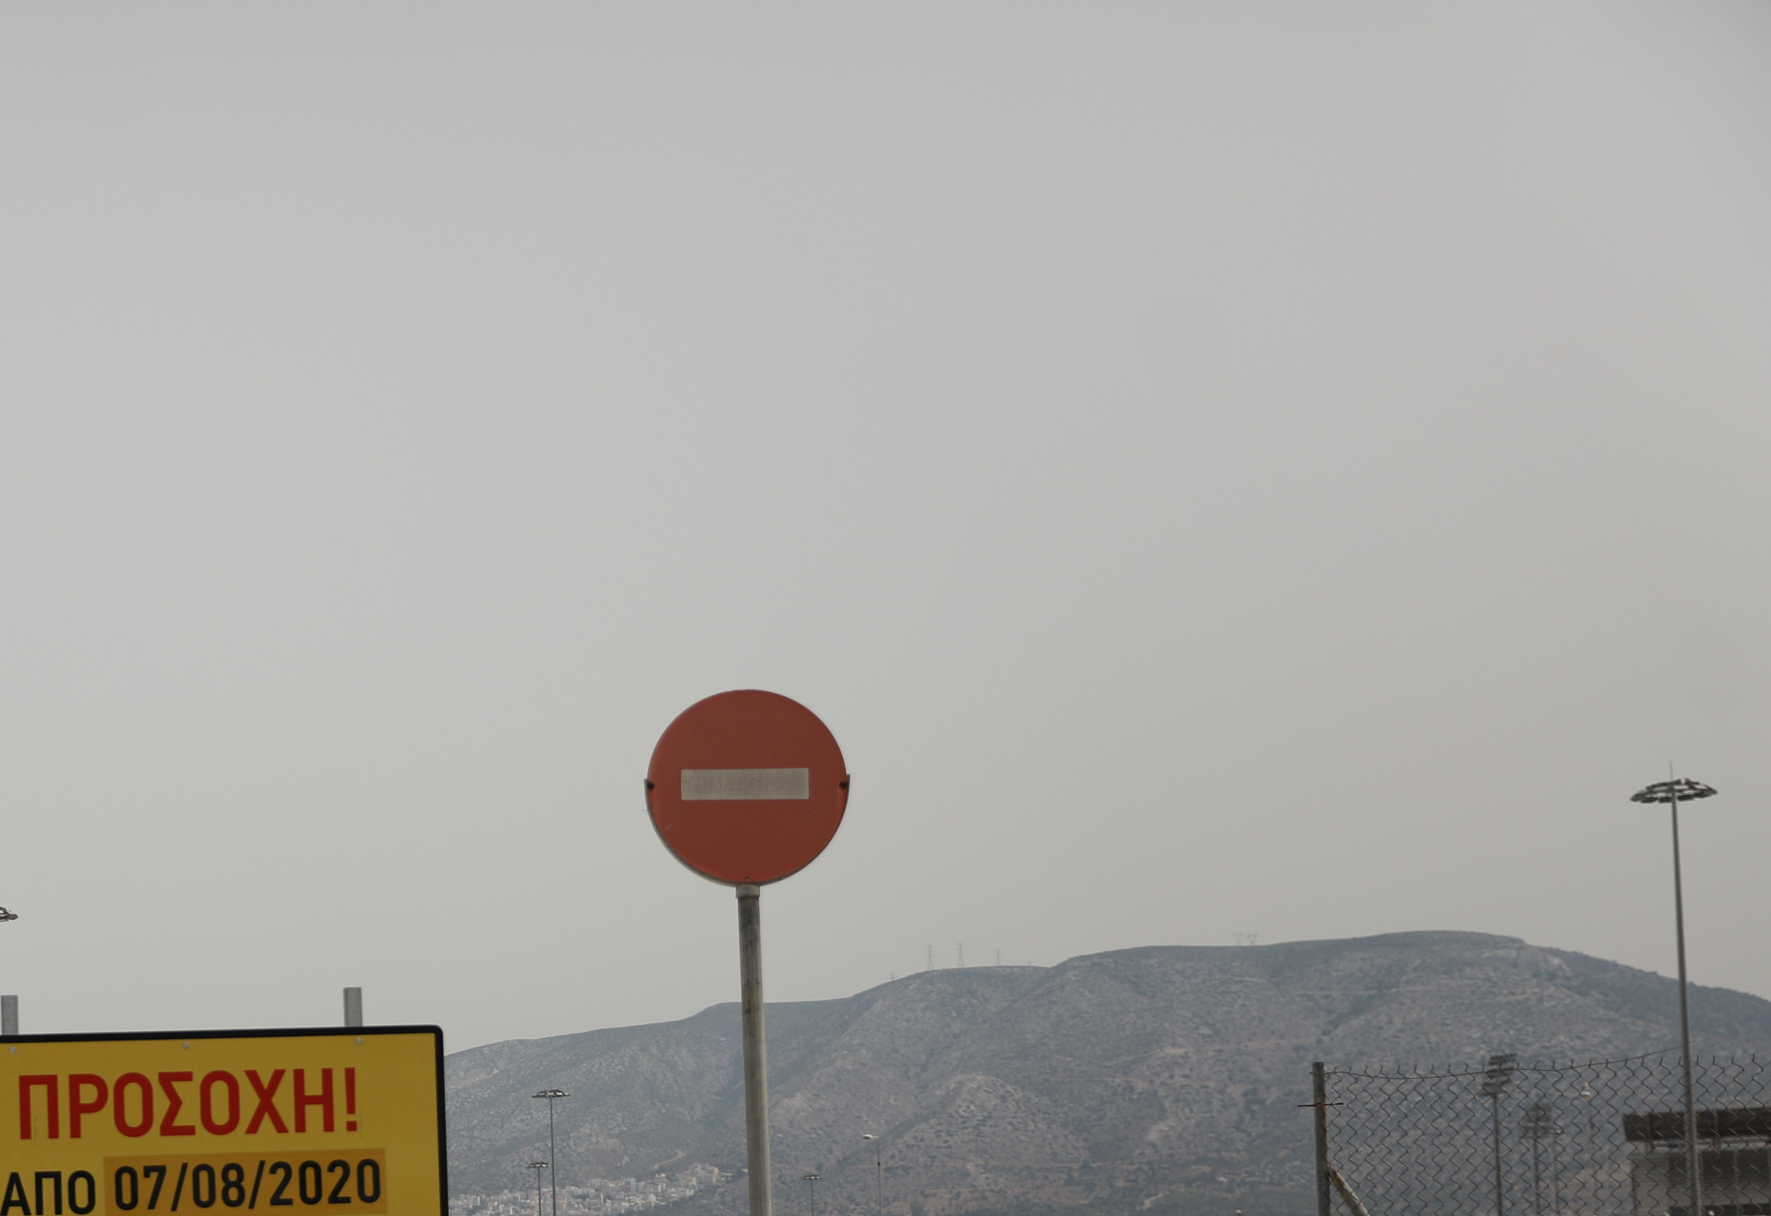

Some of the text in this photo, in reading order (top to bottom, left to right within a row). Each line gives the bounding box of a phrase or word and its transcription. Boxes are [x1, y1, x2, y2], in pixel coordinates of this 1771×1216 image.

[18, 1067, 359, 1140] ΠΡΟΣΟΧΗ!
[0, 1158, 381, 1216] ΑΠΟ 07/08/2020
